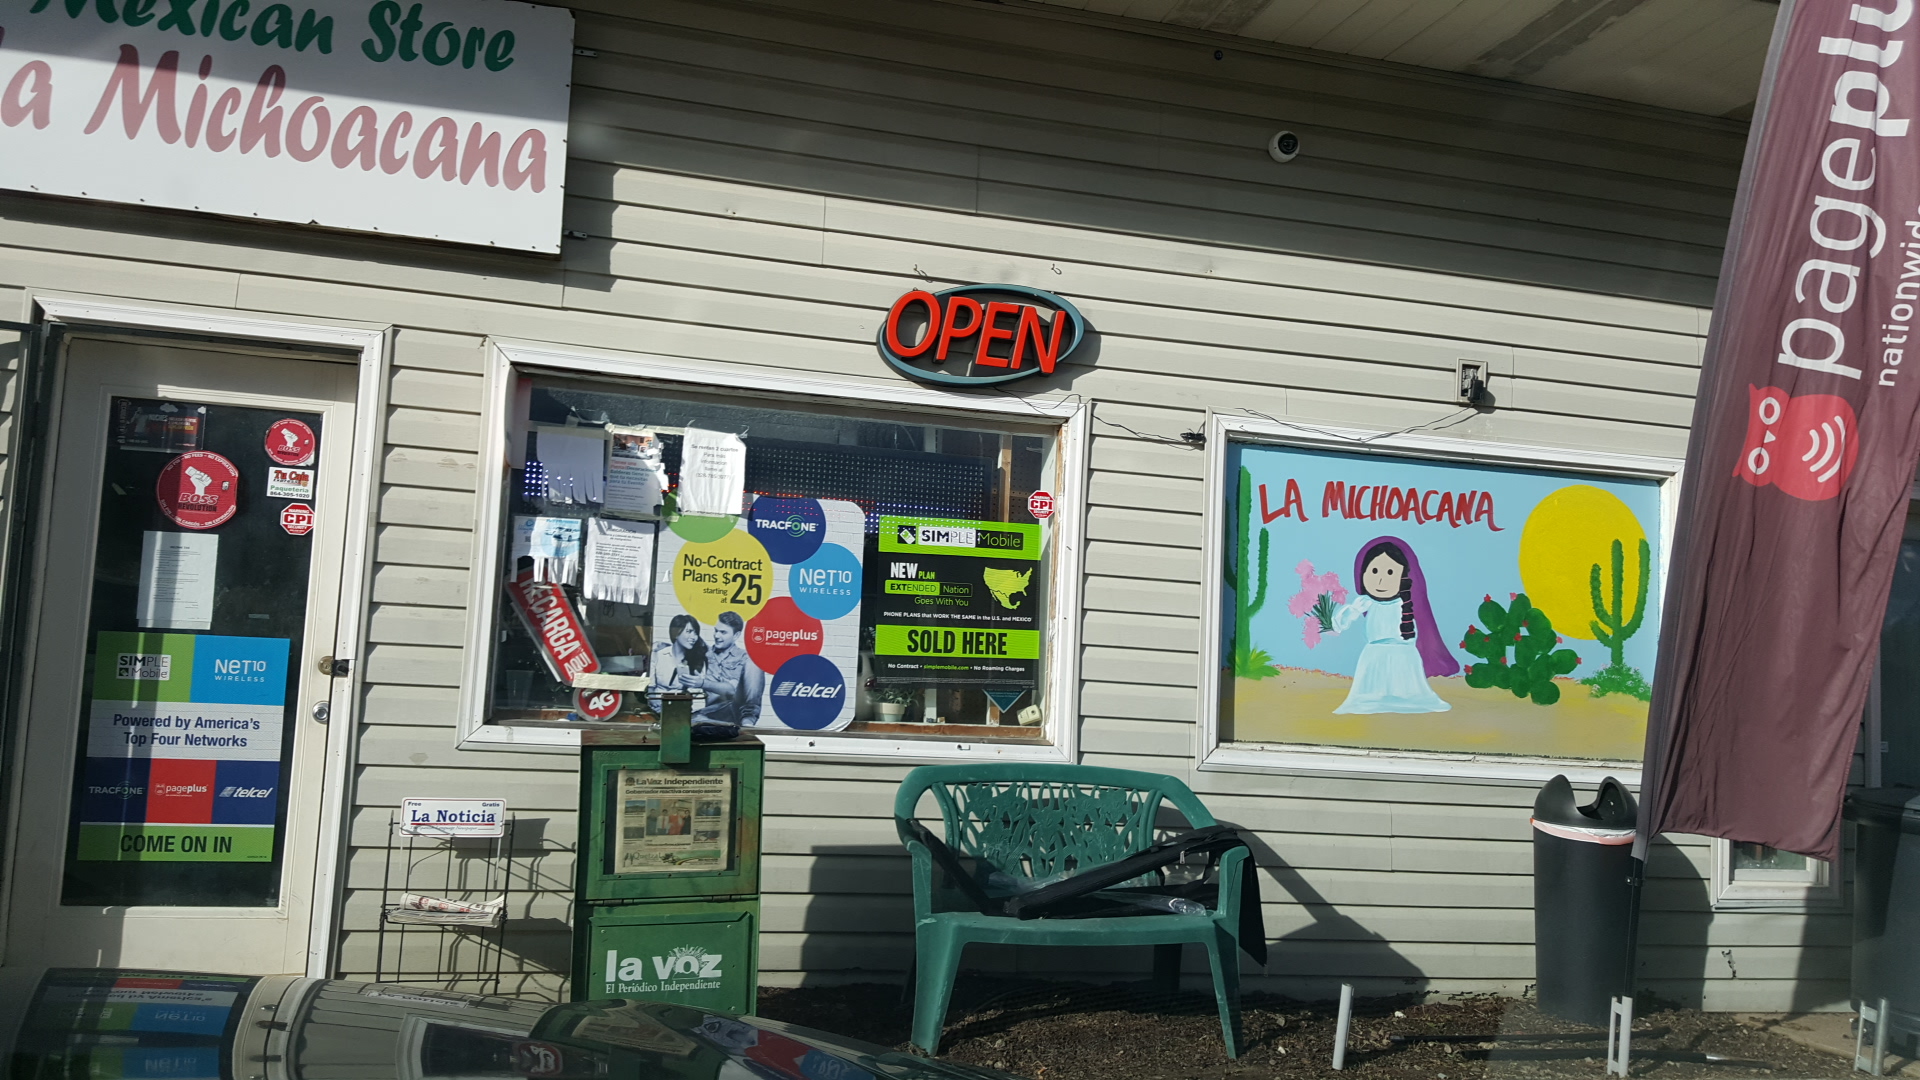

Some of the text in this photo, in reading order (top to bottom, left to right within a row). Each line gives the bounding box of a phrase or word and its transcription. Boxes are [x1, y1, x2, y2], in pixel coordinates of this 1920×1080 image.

[361, 0, 516, 72] Store
[0, 26, 547, 194] a Michoacana
[1878, 203, 1920, 387] nationwid
[886, 290, 1067, 374] OPEN
[178, 493, 219, 505] BOSS
[1030, 500, 1053, 510] CPI
[1258, 478, 1505, 532] LA MICHOACANA
[284, 514, 313, 525] CPI
[755, 518, 816, 533] TRACFONE
[921, 530, 1021, 548] SIMPLE Mobile
[683, 554, 763, 571] No-Contract
[890, 562, 936, 580] NEW PLAN
[682, 568, 762, 606] Plans $25
[703, 587, 728, 597] starting
[798, 586, 852, 596] WIRELESS
[890, 583, 969, 594] EXTENDED Nation
[914, 597, 969, 607] Goes With You
[519, 577, 582, 661] RECARGA
[765, 628, 818, 643] pageplus
[907, 629, 1008, 656] SOLD HERE
[119, 655, 169, 668] SIMPLE
[131, 667, 168, 679] Mobile
[791, 682, 842, 699] telcel
[588, 690, 615, 711] 4G
[113, 714, 171, 728] Powered
[175, 715, 191, 730] by
[124, 731, 247, 747] Top Four Networks
[165, 784, 207, 795] pageplus
[664, 778, 724, 787] Independiente
[88, 786, 144, 795] TRACFONE
[233, 786, 273, 798] telcel
[411, 809, 496, 823] La Noticia
[121, 835, 233, 853] COME ON IN
[605, 949, 723, 983] la voz
[605, 979, 721, 994] El Periódico Independiente
